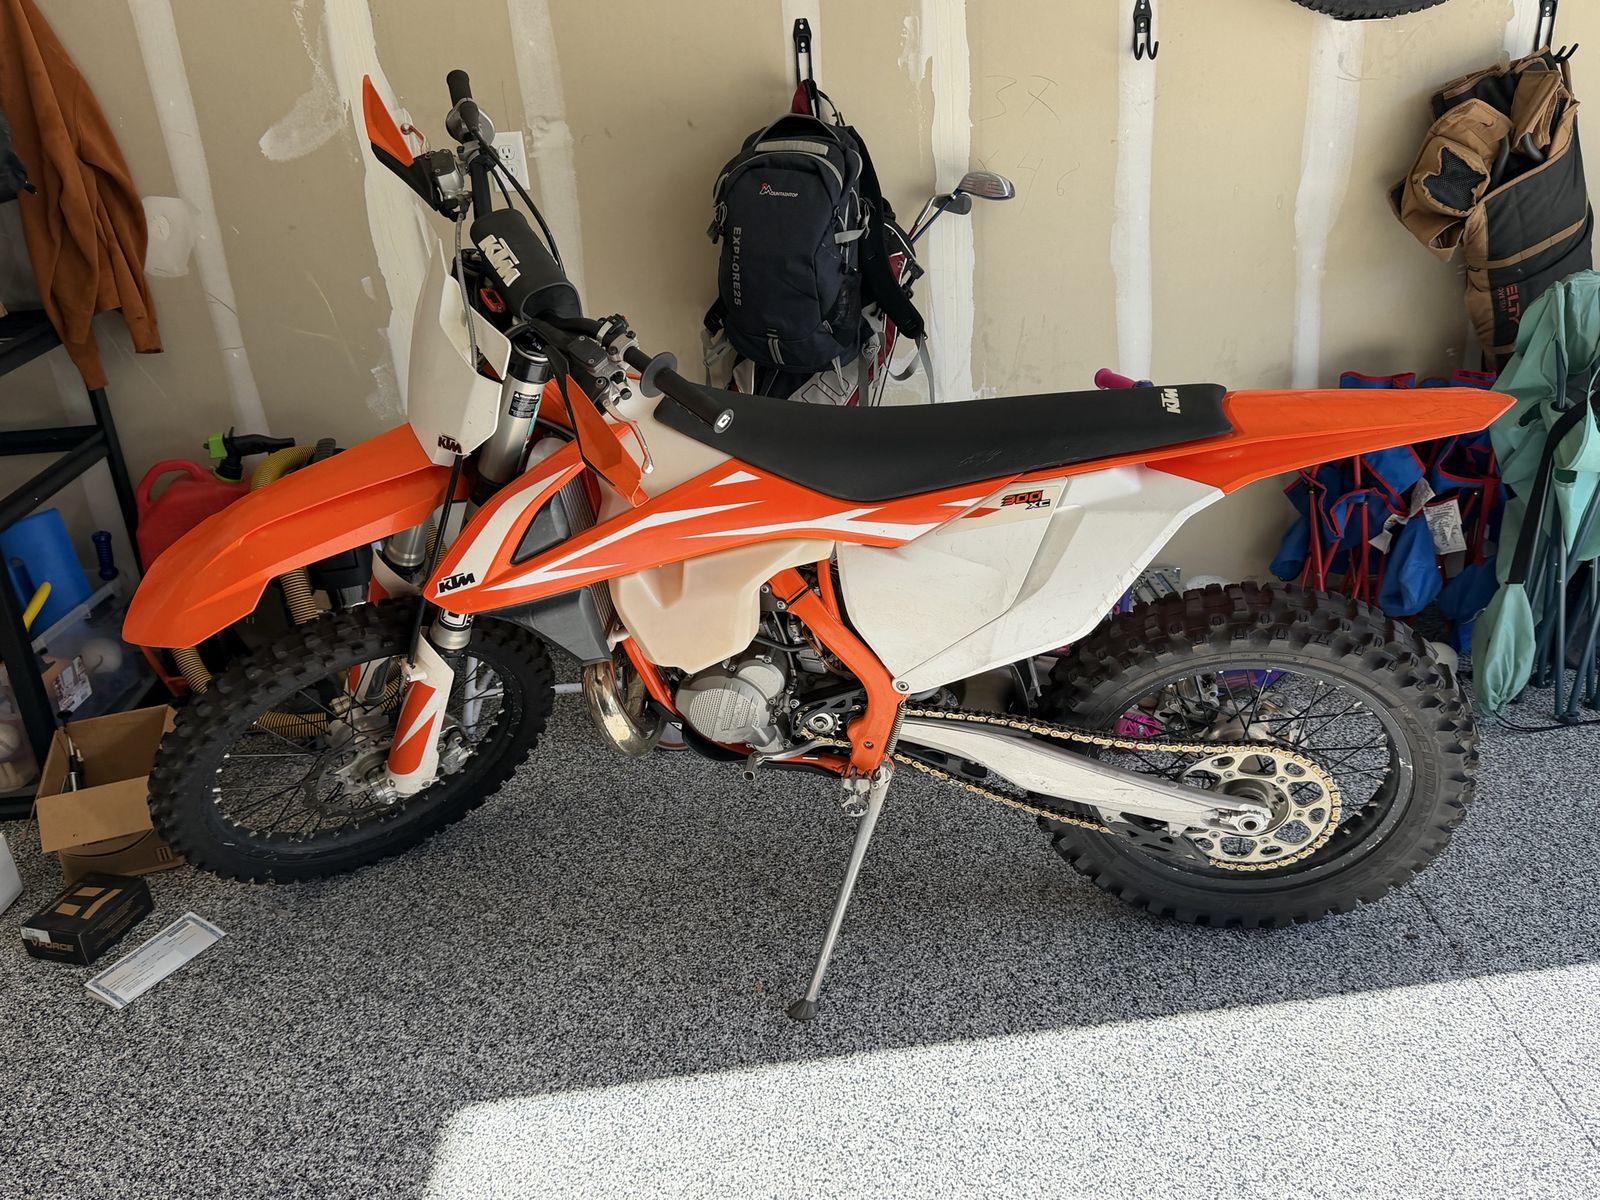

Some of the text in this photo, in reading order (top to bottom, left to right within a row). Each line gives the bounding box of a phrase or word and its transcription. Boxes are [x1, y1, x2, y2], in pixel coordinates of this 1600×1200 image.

[478, 233, 521, 288] KTM
[731, 226, 743, 307] EXPLORE25
[1505, 284, 1520, 325] ELTY
[1160, 388, 1181, 414] KTM
[437, 434, 463, 454] KTM
[1001, 489, 1051, 511] 300 XC
[438, 572, 476, 594] KTM
